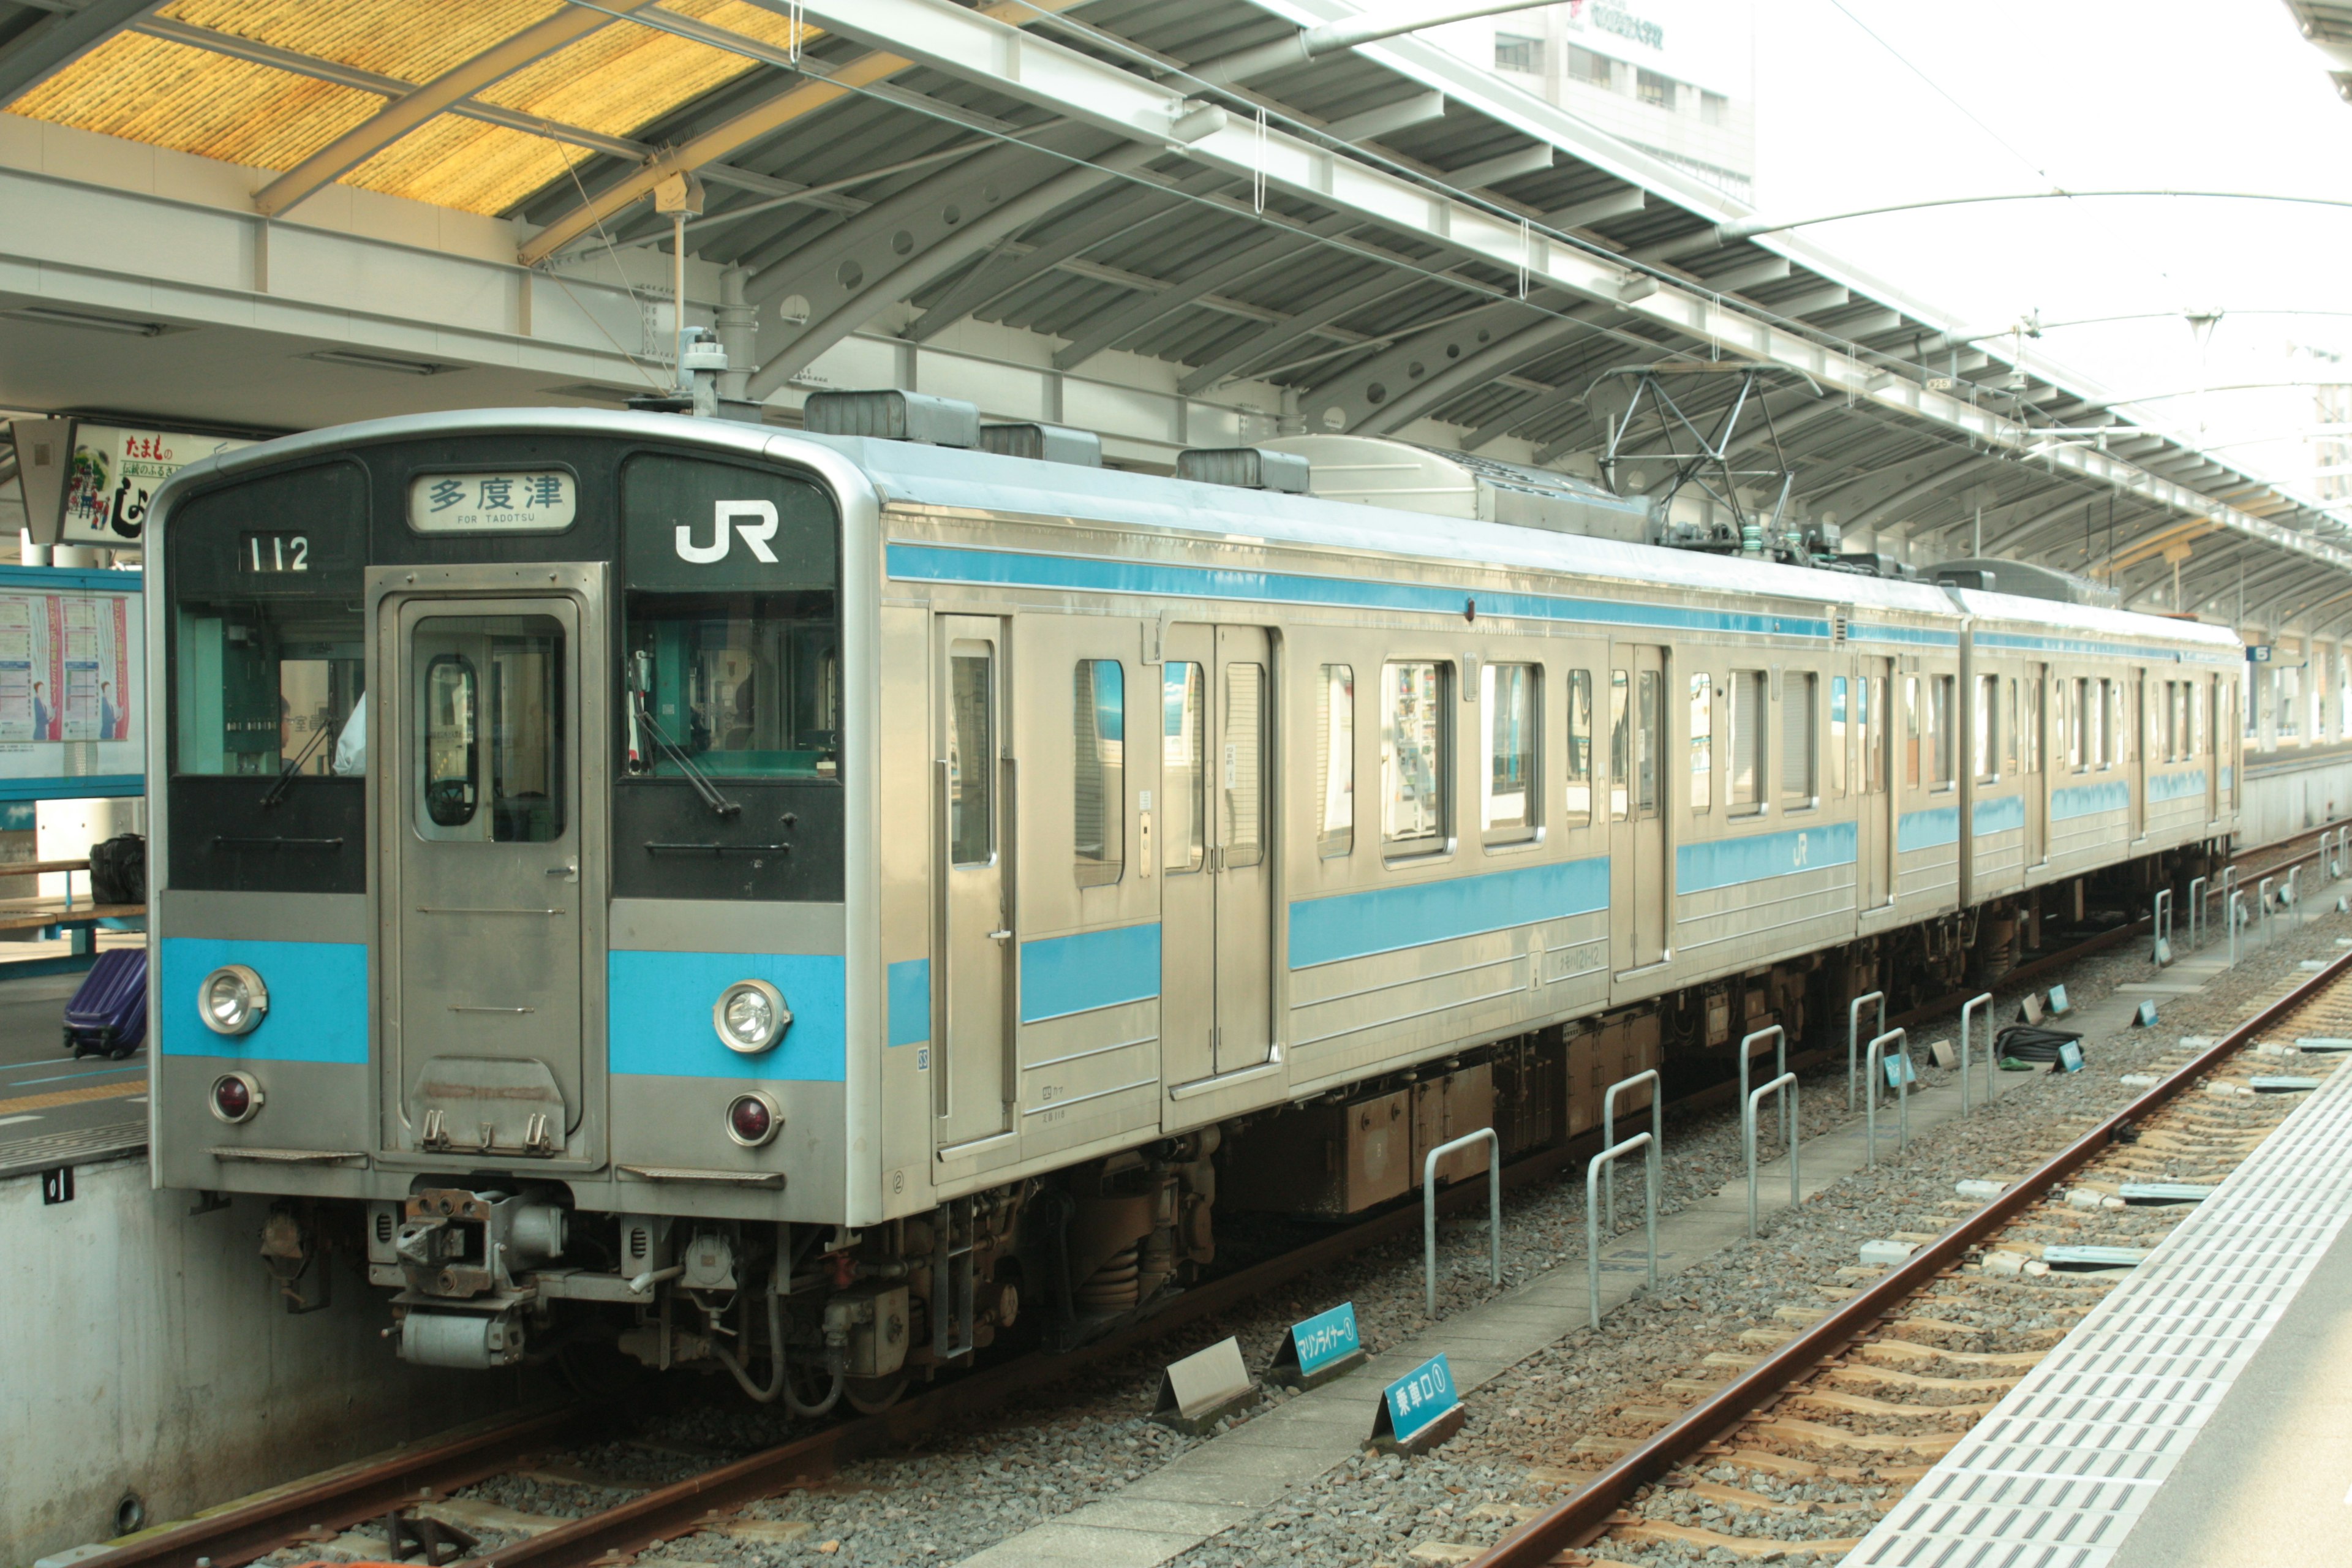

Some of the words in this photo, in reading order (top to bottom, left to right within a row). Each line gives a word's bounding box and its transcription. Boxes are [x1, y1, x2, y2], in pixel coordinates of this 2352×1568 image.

[126, 434, 173, 461] たまもの
[429, 475, 563, 513] 多度津
[458, 515, 477, 524] FOR
[486, 513, 535, 523] TADOTSU
[675, 499, 780, 564] JR
[251, 535, 308, 572] 112
[2256, 647, 2268, 660] 5
[1793, 832, 1807, 867] JR
[1559, 945, 1599, 971] クモハ121-12
[918, 1051, 928, 1068] SS
[1395, 1363, 1446, 1417] 乗車口①
